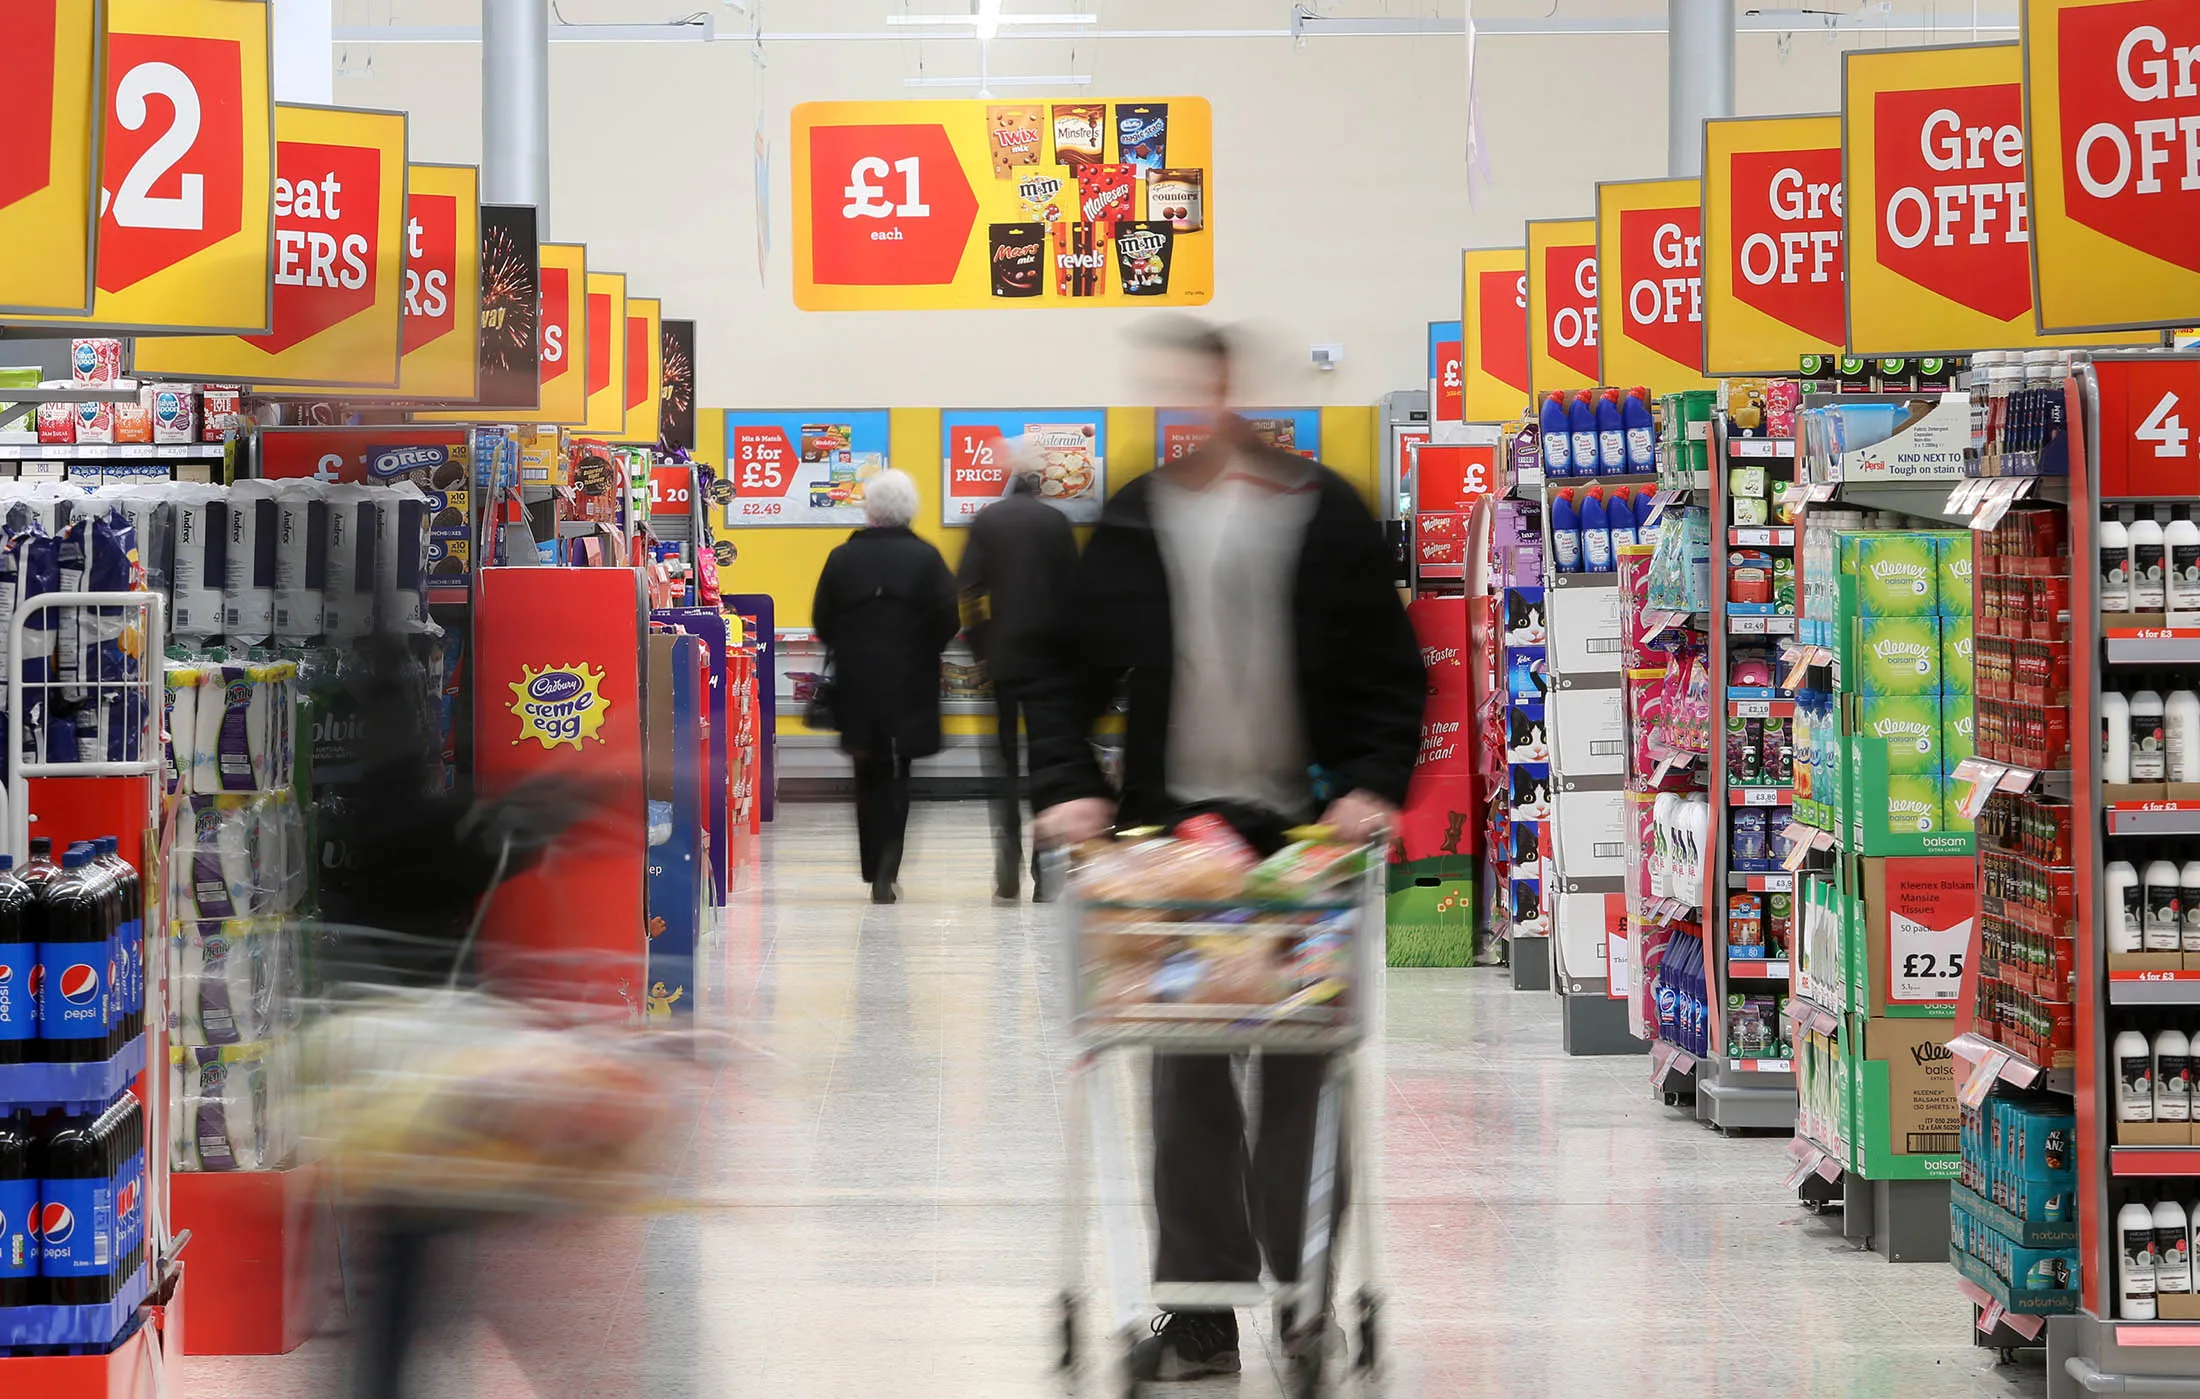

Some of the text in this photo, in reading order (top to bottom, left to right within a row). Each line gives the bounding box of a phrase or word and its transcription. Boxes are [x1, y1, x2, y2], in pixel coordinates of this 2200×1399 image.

[994, 127, 1039, 147] Twix
[1058, 127, 1100, 140] Minstrels
[1921, 108, 2023, 171] Gre
[100, 62, 204, 230] 2
[842, 156, 930, 219] £1
[1083, 183, 1129, 223] Maltesers
[1152, 191, 1198, 202] counters
[870, 227, 904, 242] each
[993, 243, 1040, 263] Mars
[1016, 255, 1036, 265] mix
[1057, 250, 1105, 269] revels
[540, 324, 562, 362] S
[742, 435, 754, 443] Mix
[762, 435, 782, 443] Match
[452, 446, 467, 455] x10
[742, 444, 782, 460] 3 for
[1171, 444, 1183, 458] 3
[376, 449, 442, 472] OREO
[1897, 453, 1961, 463] KIND NEXT TO
[1864, 460, 1885, 473] Persil
[1889, 465, 1917, 477] Tough
[1933, 464, 1955, 474] stain
[741, 461, 782, 489] £5
[955, 469, 1003, 482] PRICE
[1462, 463, 1488, 494] £
[451, 493, 465, 501] x10
[667, 489, 689, 502] 20
[742, 503, 782, 515] £2.49
[183, 509, 193, 545] Andrex
[233, 509, 243, 545] Andrex
[283, 509, 293, 545] Andrex
[334, 512, 343, 547] Andrex
[451, 541, 466, 550] x10
[1870, 559, 1927, 581] Kleenex
[2137, 629, 2173, 638] 4 for £3
[1873, 639, 1930, 660] Kleenex
[532, 677, 577, 697] Cadbury
[524, 692, 594, 718] creme
[1748, 705, 1769, 713] £2.19
[533, 714, 581, 739] egg
[1431, 721, 1459, 734] them
[1873, 717, 1932, 738] Kleenex
[1429, 743, 1456, 762] can!
[2142, 802, 2177, 811] 4 for £3
[1922, 836, 1967, 847] balsam
[649, 864, 662, 877] ep
[1901, 880, 1974, 890] Kleenex Balsam
[1901, 893, 1940, 902] Mansize
[1901, 905, 1936, 914] Tissues
[1903, 953, 1963, 979] £2.5
[2139, 971, 2175, 981] 4 for £3
[0, 985, 12, 1022] pepsi
[64, 1007, 97, 1021] pepsi
[44, 1246, 71, 1260] pepsi
